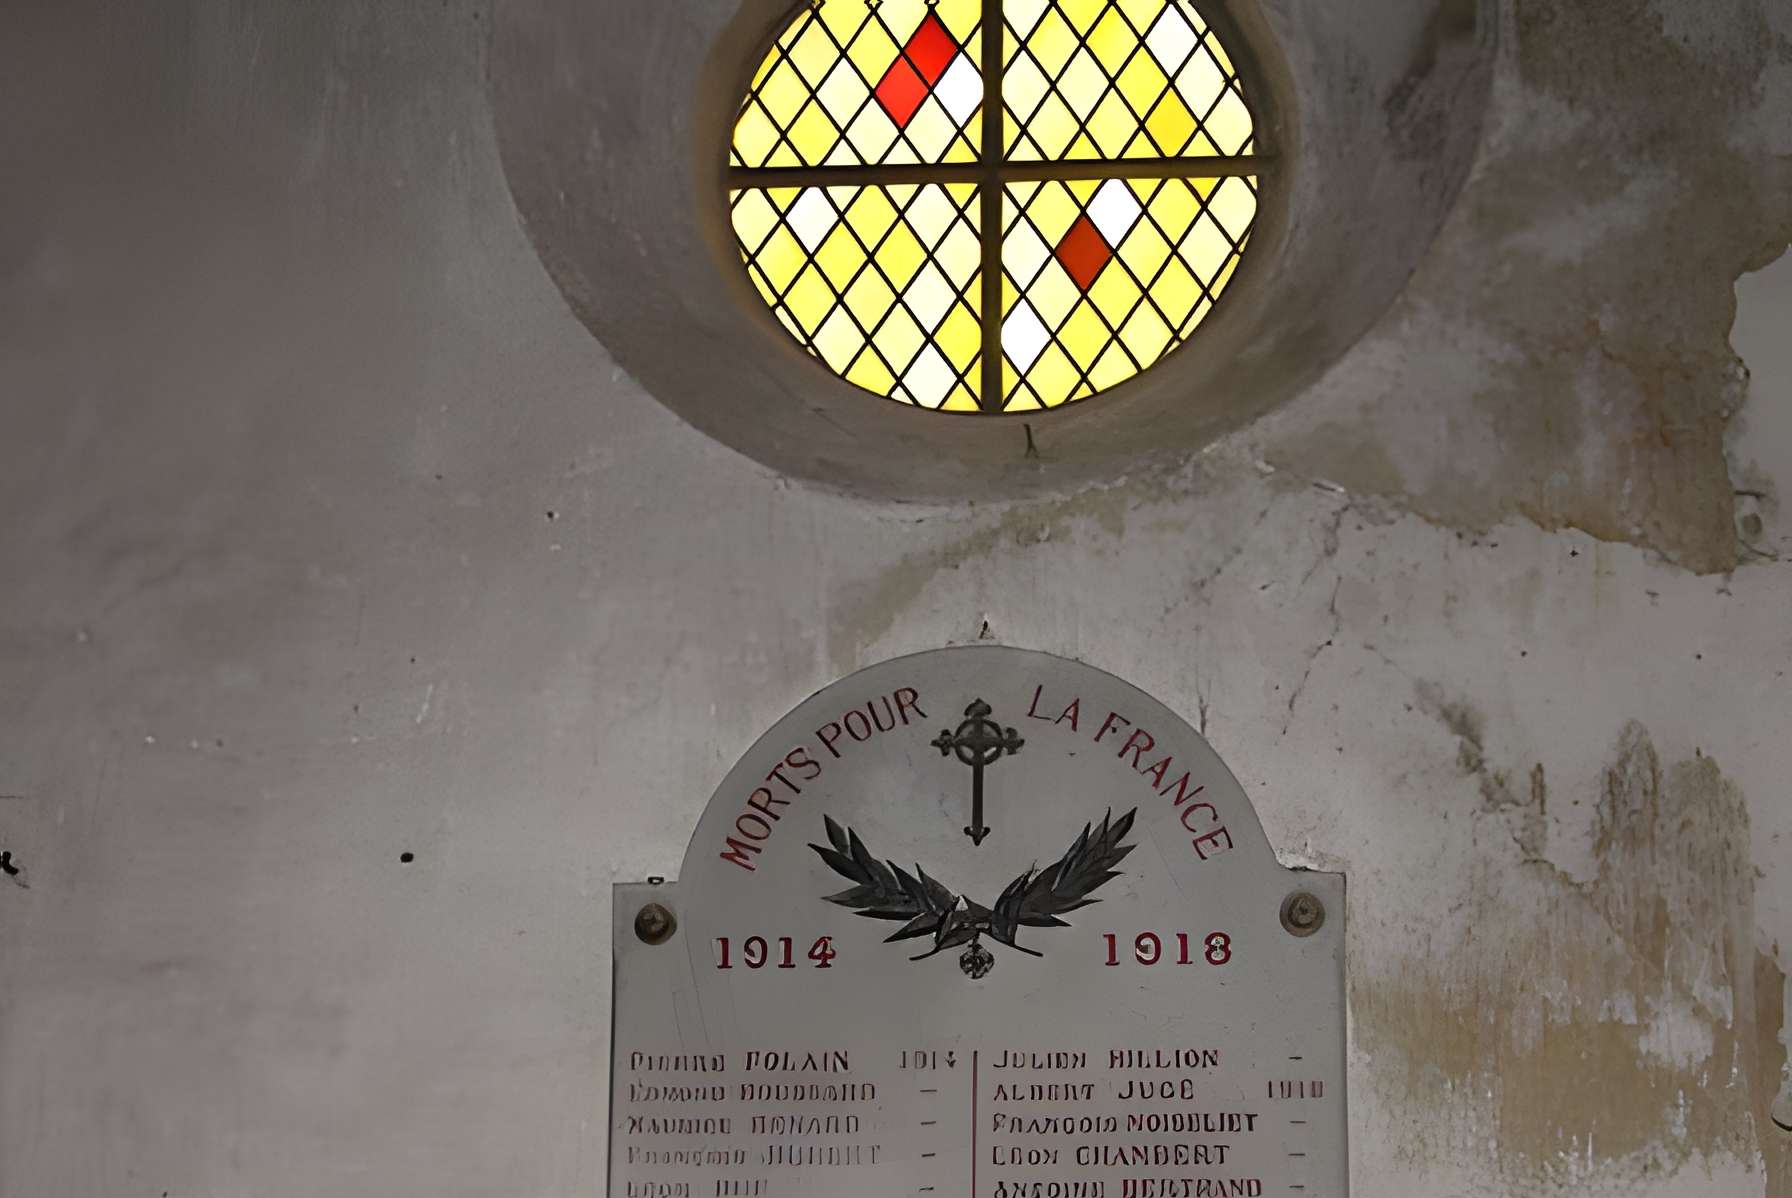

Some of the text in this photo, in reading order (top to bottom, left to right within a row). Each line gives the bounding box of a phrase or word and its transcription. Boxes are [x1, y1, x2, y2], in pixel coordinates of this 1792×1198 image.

[719, 684, 1234, 872] MORTS POUR LA FRANCE
[714, 936, 836, 969] 1914
[1103, 932, 1233, 966] 1918
